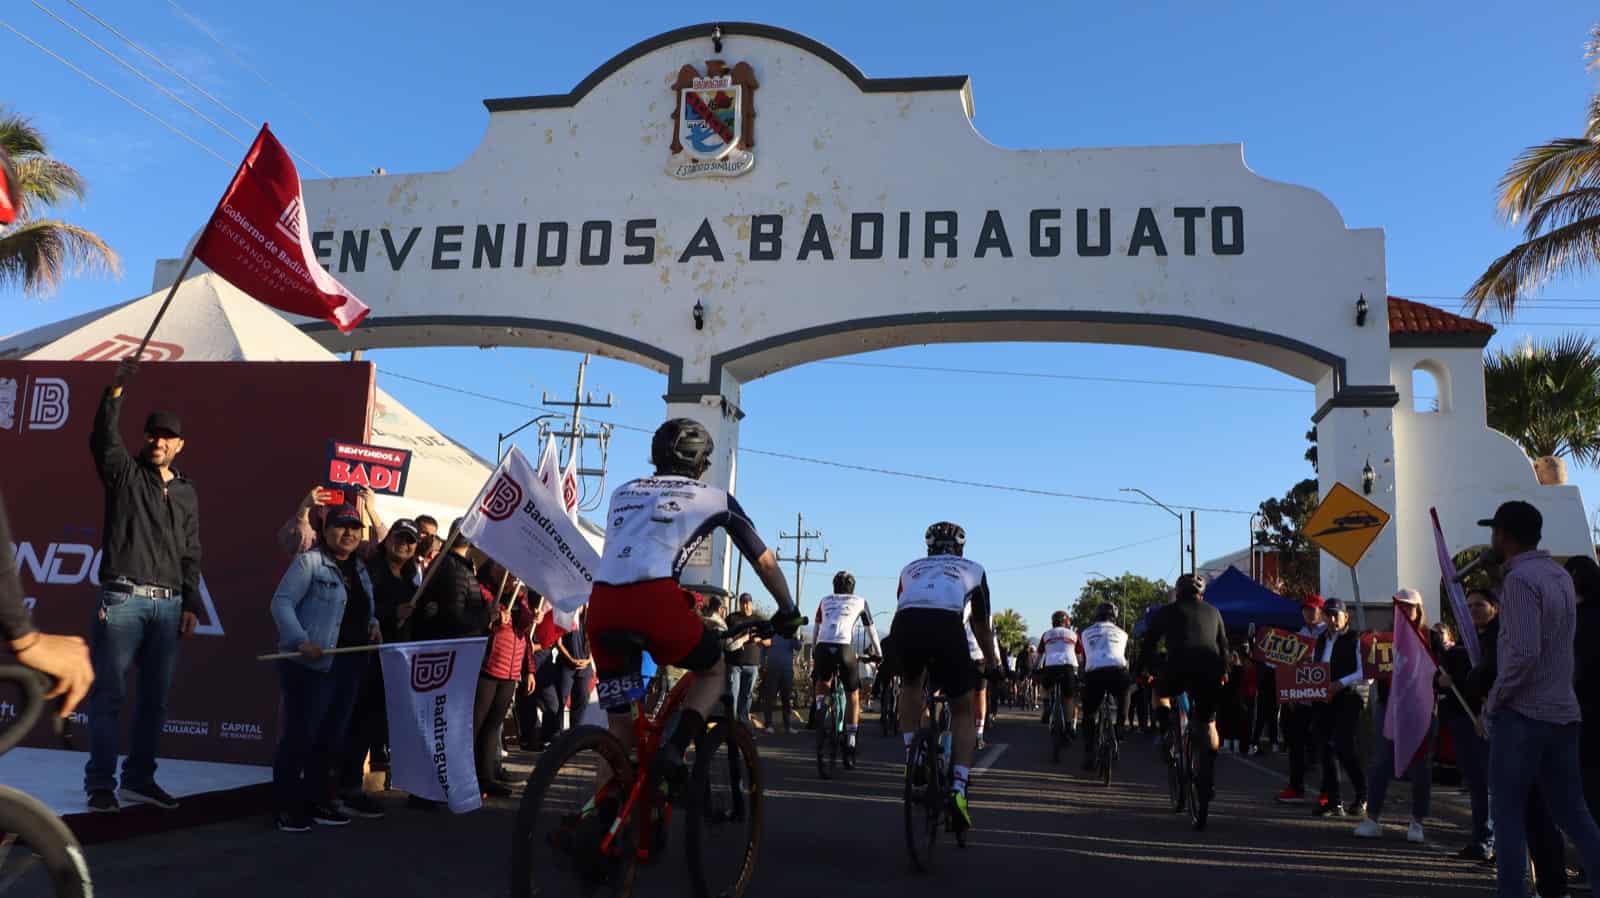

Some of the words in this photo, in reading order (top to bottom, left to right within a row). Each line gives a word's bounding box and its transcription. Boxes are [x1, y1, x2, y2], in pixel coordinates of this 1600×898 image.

[222, 204, 266, 243] Gobierno
[264, 238, 278, 254] de
[312, 218, 656, 272] ENVENIDOS
[678, 217, 724, 262] A
[749, 206, 1245, 261] BADIRAGUATO
[338, 446, 393, 461] BIENVENIDOS
[393, 455, 401, 463] A
[329, 459, 402, 493] BADI
[523, 499, 593, 583] Badiraguato
[1296, 667, 1327, 685] NO
[1289, 688, 1328, 699] RINDAS
[221, 722, 264, 734] CAPITAL
